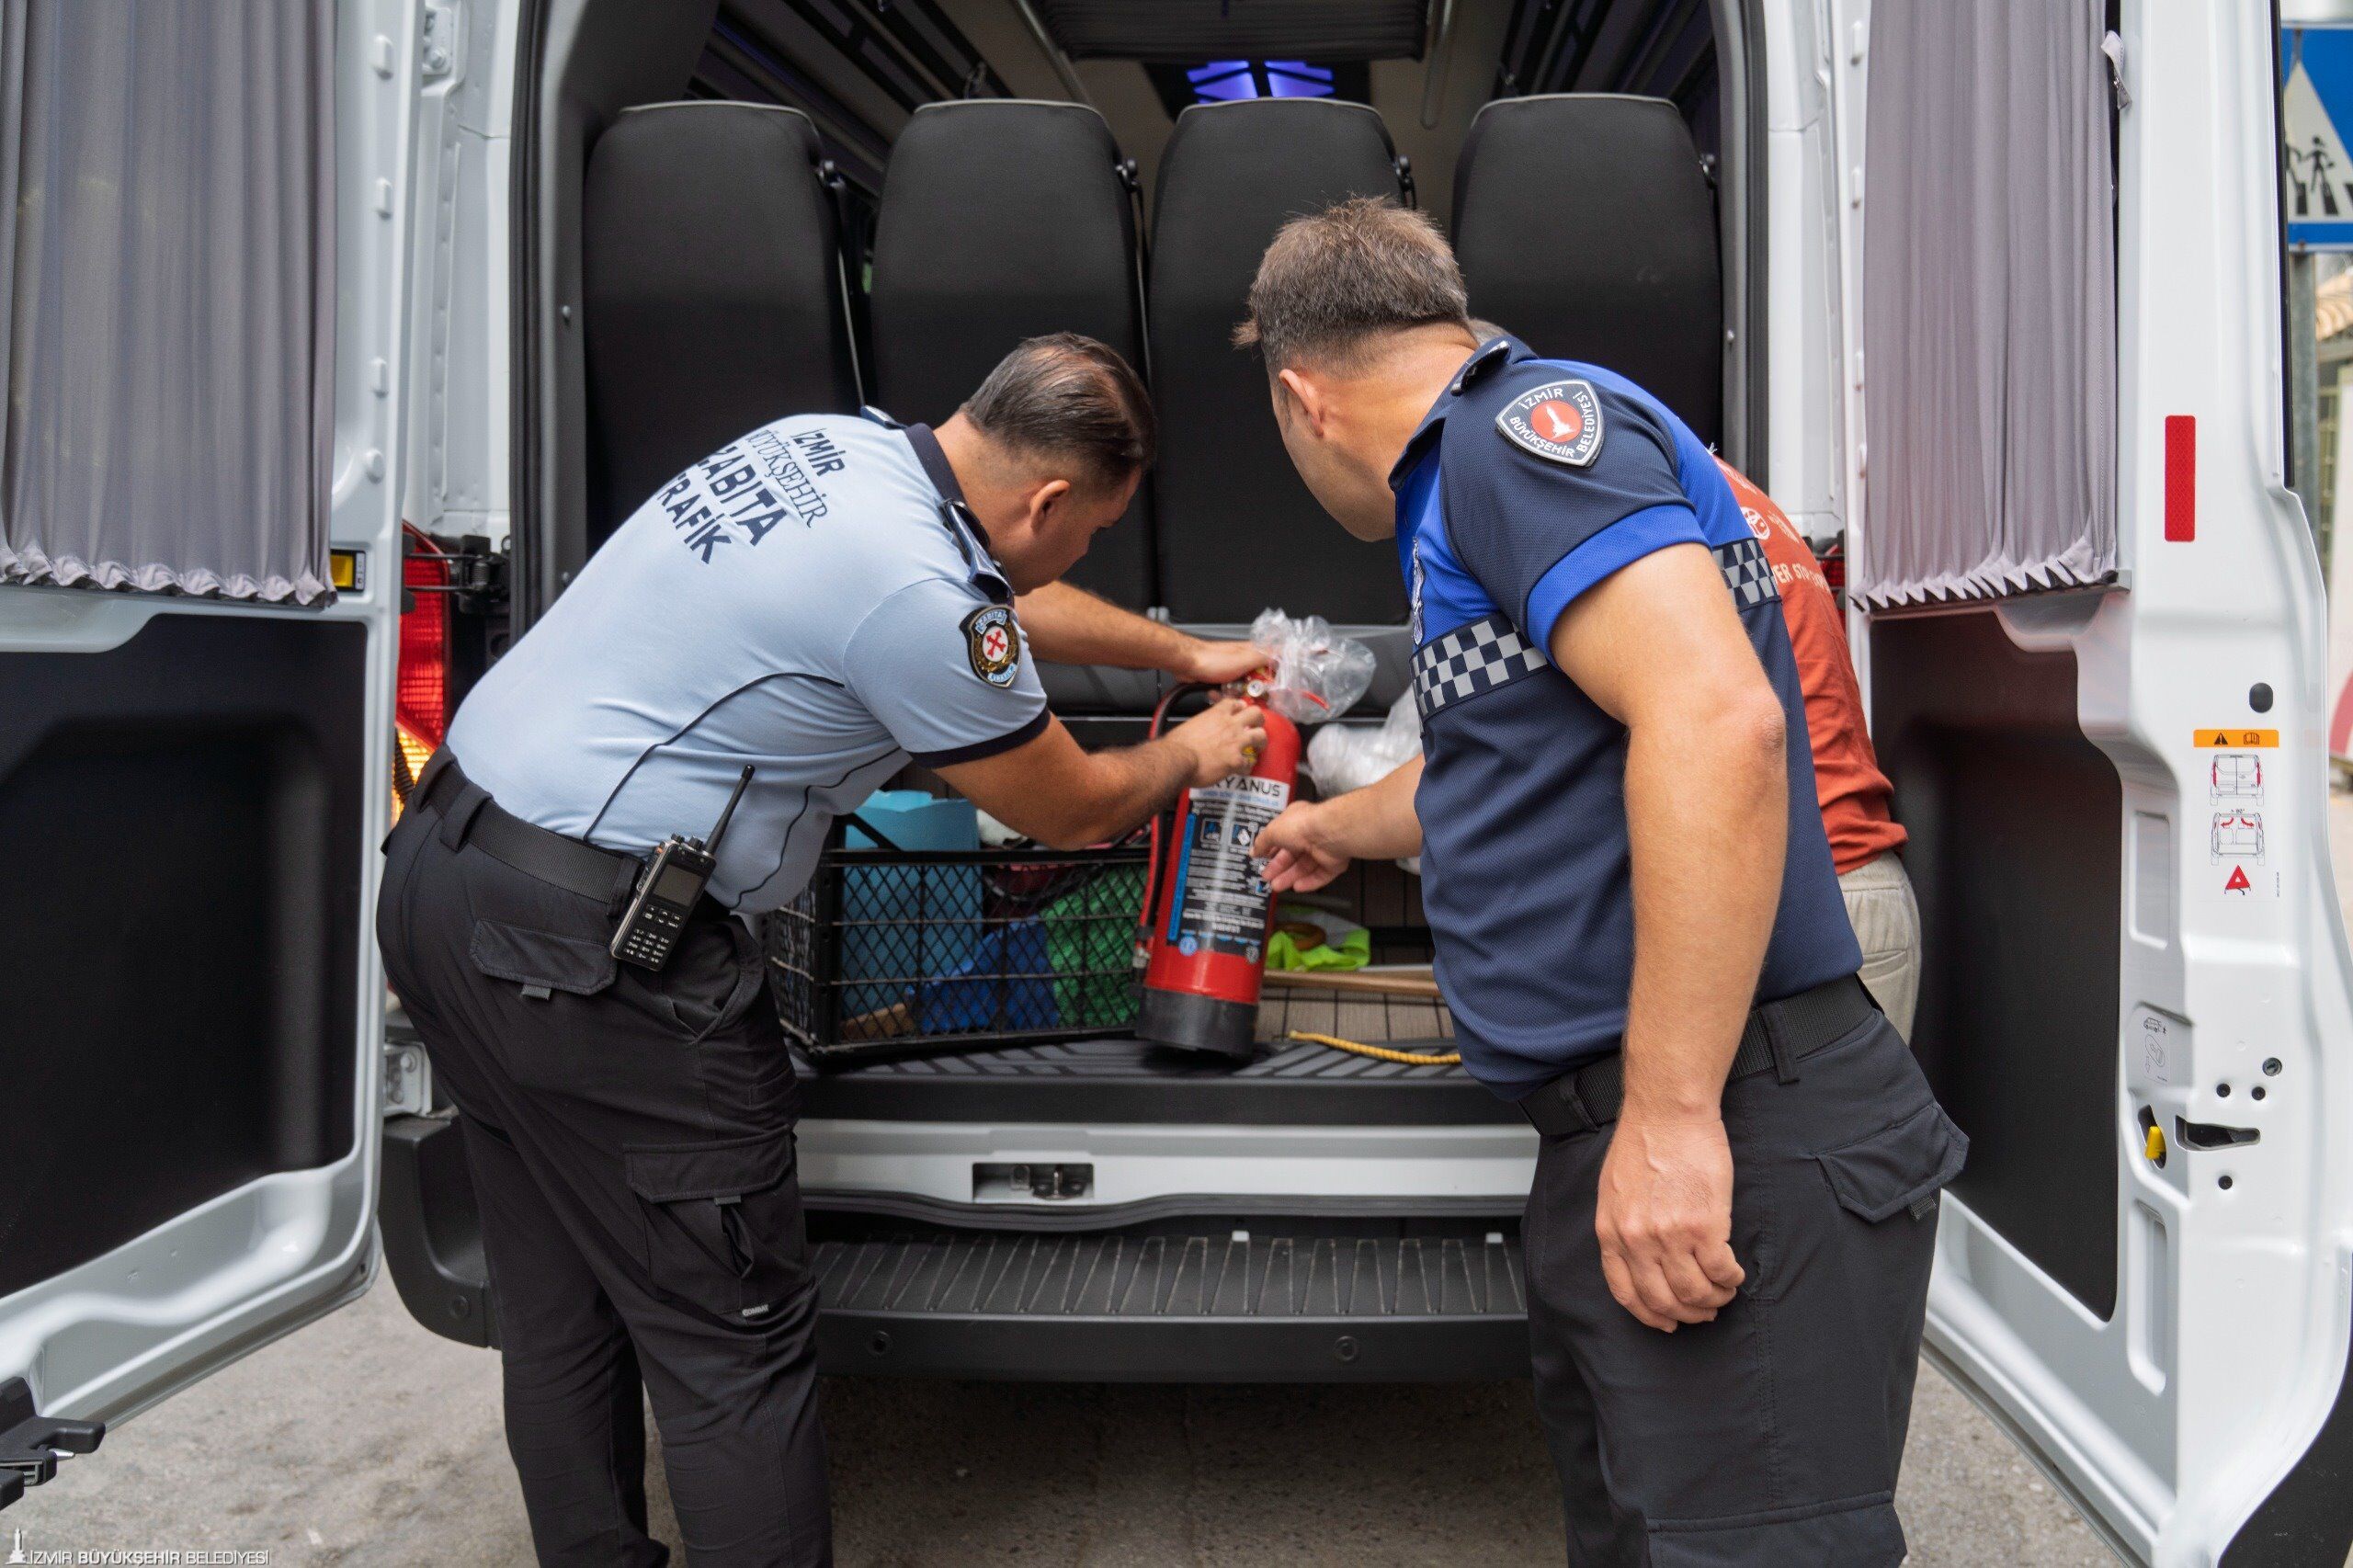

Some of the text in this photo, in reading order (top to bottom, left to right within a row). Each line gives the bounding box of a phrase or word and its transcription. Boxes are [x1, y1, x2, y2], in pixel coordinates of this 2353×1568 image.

[1518, 388, 1563, 410] İZMİR
[1573, 391, 1596, 453] BELEDİYESİ
[790, 427, 847, 477] İZMİR
[1510, 416, 1575, 458] BÜYÜKŞEHİR
[656, 472, 733, 565] RAFİK
[1215, 777, 1280, 797] YANUS
